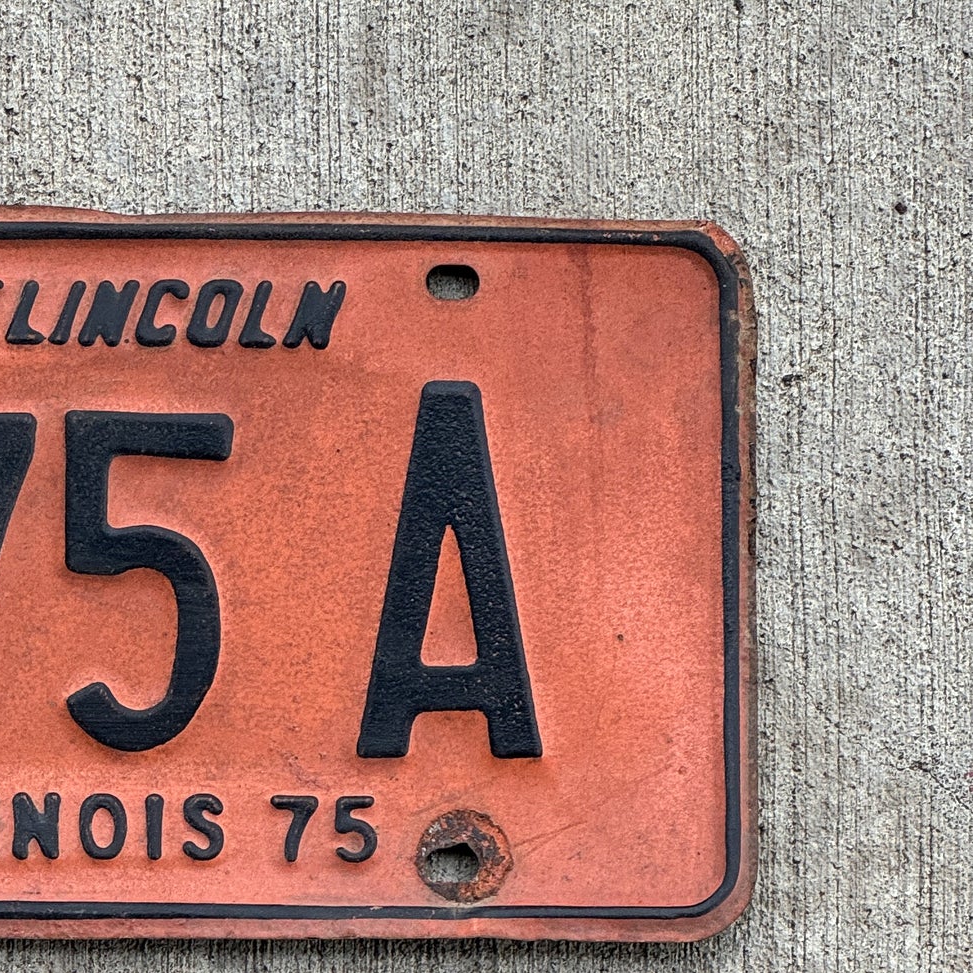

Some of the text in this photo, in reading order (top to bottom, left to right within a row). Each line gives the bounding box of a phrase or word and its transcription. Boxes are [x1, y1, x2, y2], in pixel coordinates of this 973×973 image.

[4, 279, 347, 351] LINCOLN
[356, 380, 543, 760] A
[270, 794, 378, 864] 75
